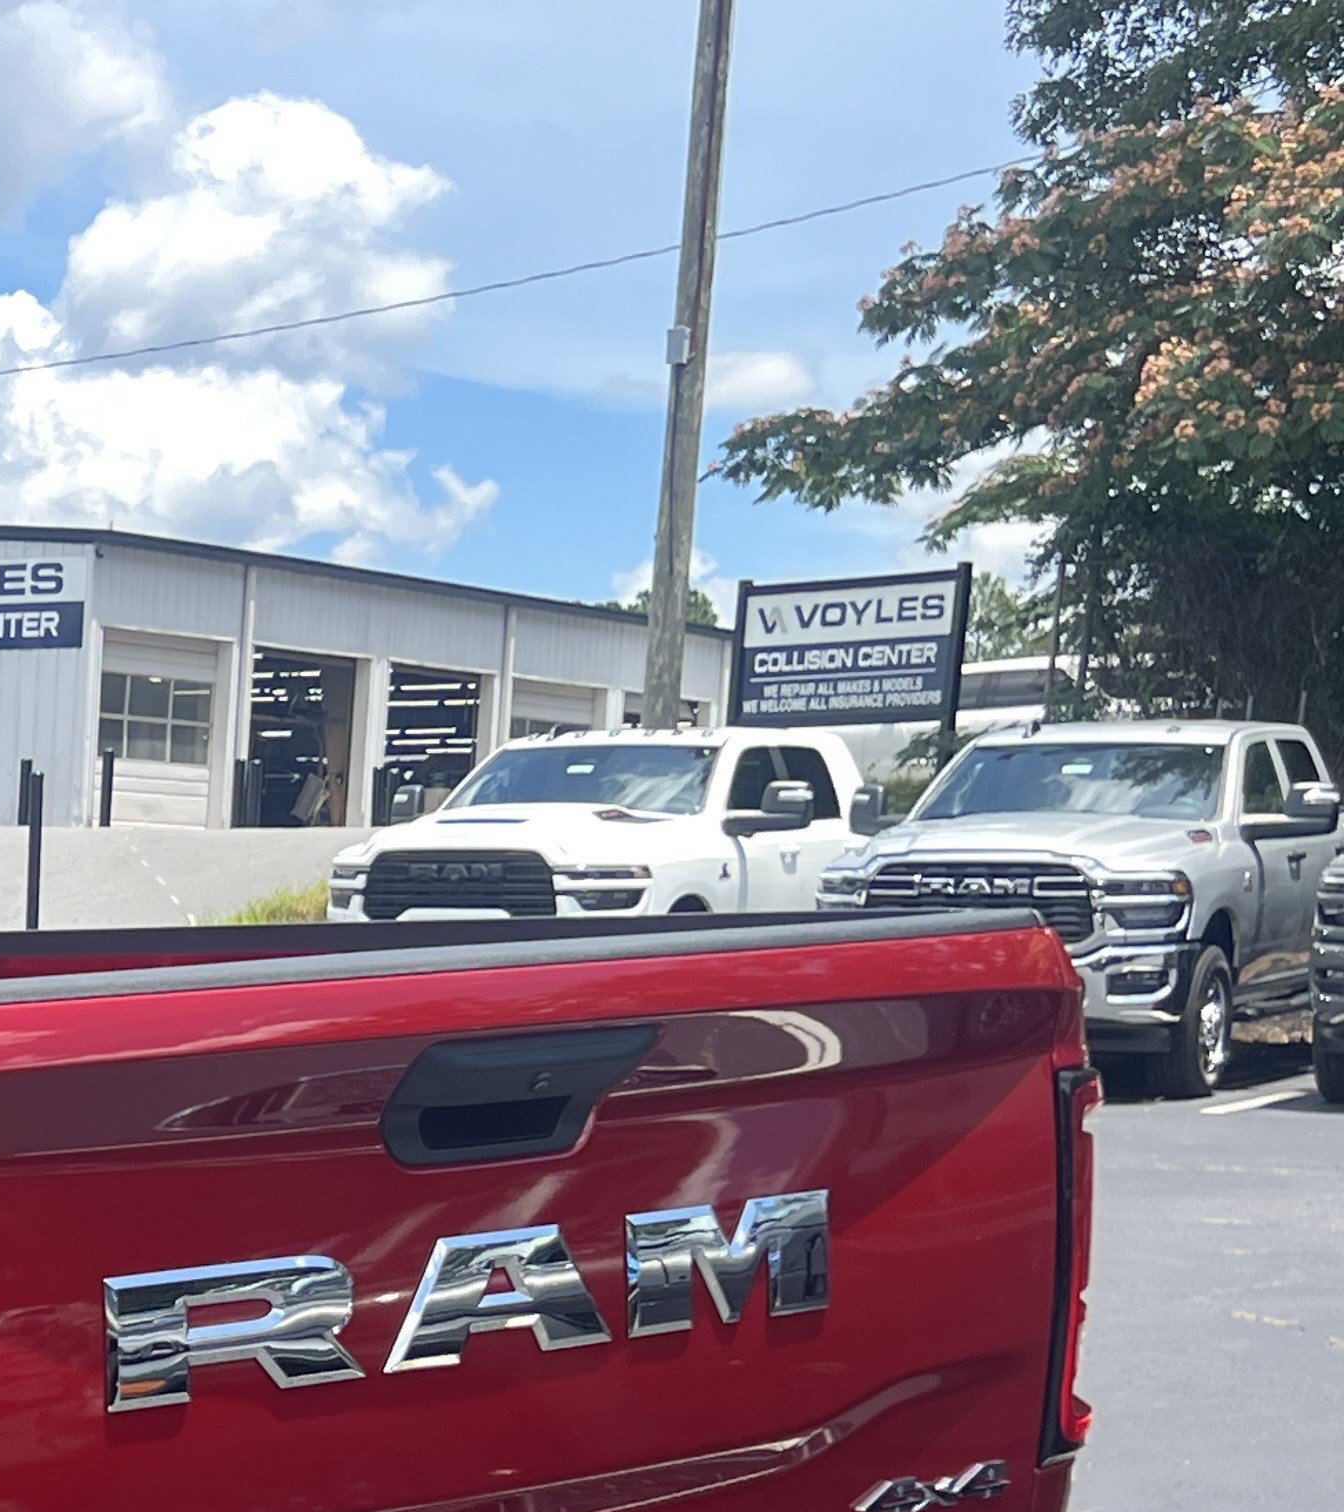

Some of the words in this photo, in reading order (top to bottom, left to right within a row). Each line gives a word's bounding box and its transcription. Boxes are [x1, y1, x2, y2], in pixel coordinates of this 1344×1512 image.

[794, 594, 945, 629] VOYLES
[754, 648, 854, 674] COLLISION
[858, 642, 938, 668] CENTER
[817, 682, 835, 695] ALL
[808, 697, 827, 710] ALL
[919, 876, 1030, 895] RAM
[103, 1188, 829, 1413] RAM
